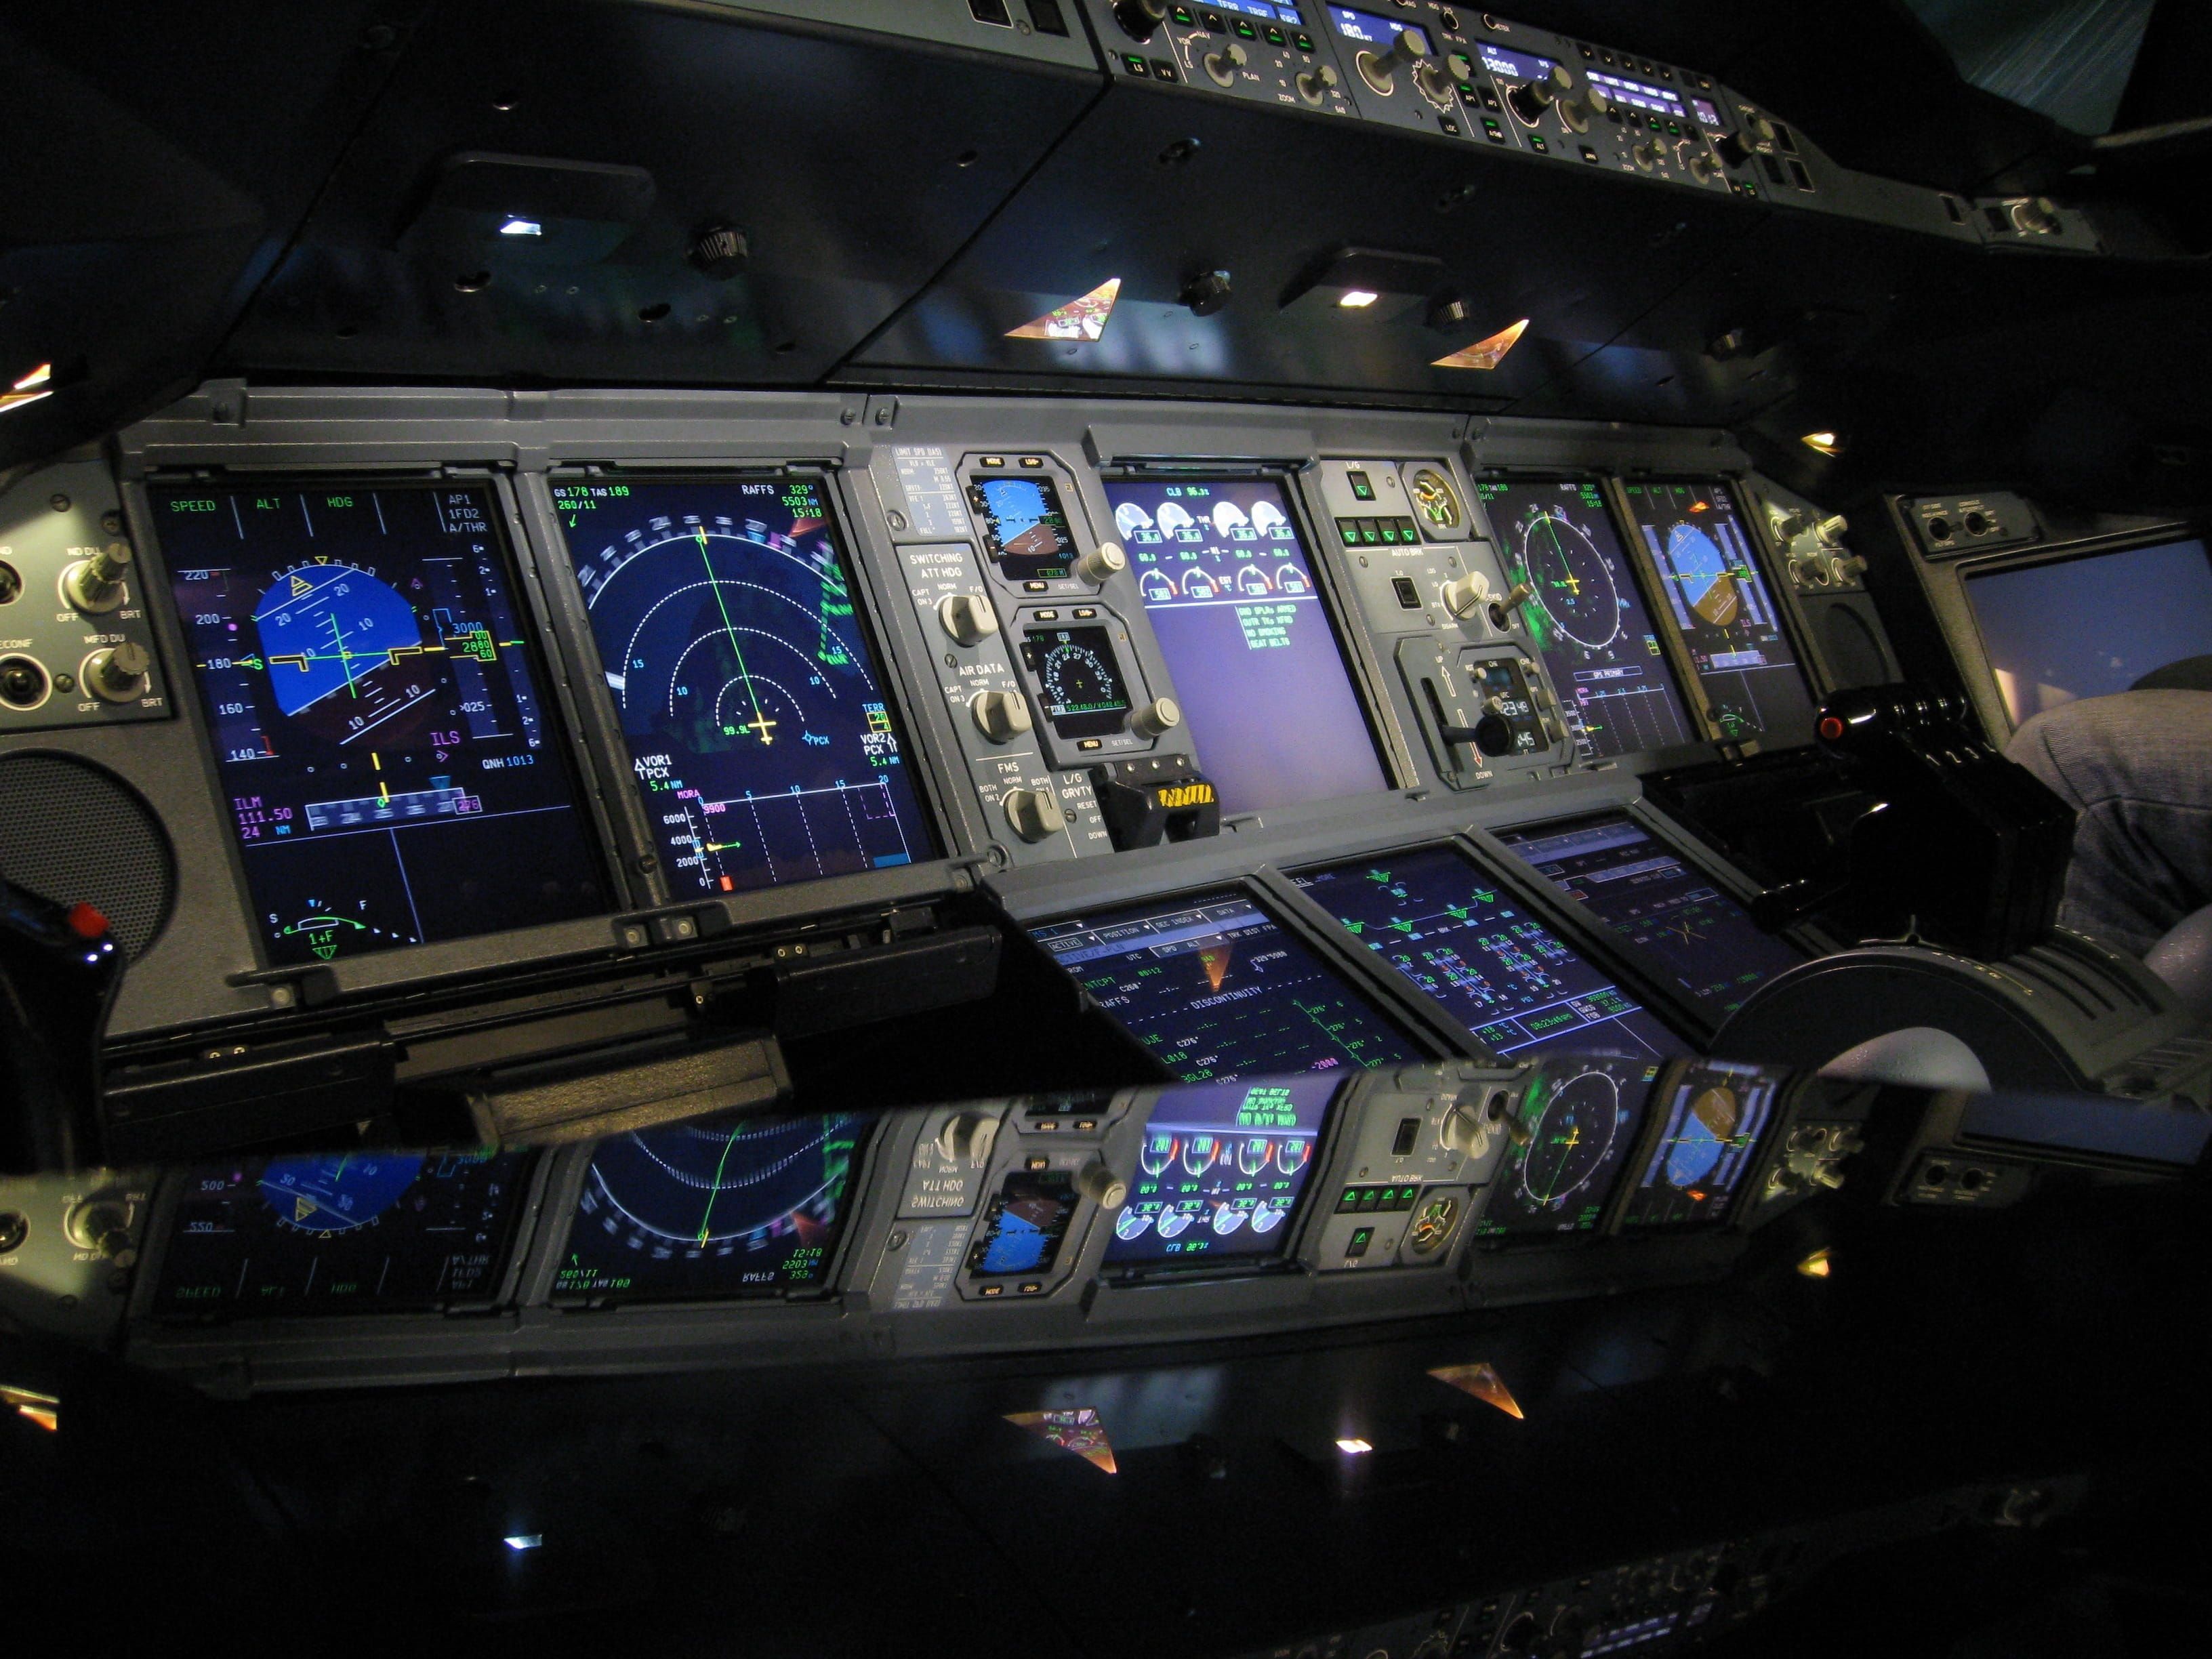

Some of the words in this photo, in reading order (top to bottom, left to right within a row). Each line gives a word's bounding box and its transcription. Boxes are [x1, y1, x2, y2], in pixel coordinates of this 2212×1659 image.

[1134, 64, 1143, 73] LS
[1242, 72, 1261, 81] PLAN
[986, 457, 1002, 466] MODE
[554, 488, 566, 497] GS
[567, 487, 589, 498] 178
[590, 487, 608, 497] TAS
[609, 486, 630, 497] 189
[741, 484, 775, 495] RAFFS
[1166, 487, 1182, 497] CLB
[256, 497, 281, 510] ALT
[327, 497, 353, 508] HDG
[449, 494, 470, 505] AP1
[171, 499, 216, 512] SPEED
[449, 508, 480, 519] 1FD2
[792, 507, 822, 518] 15:18
[449, 523, 487, 533] A/THR
[1391, 548, 1409, 556] AUTO
[909, 552, 963, 565] SWITCHING
[185, 571, 209, 581] 220
[921, 567, 939, 579] ATT
[942, 567, 962, 577] HDG
[334, 583, 350, 597] 20
[937, 582, 957, 592] NORM
[969, 586, 983, 594] F/O
[912, 588, 930, 597] CAPT
[56, 613, 79, 622] OFF
[120, 610, 141, 619] BRT
[196, 613, 220, 625] 200
[1040, 611, 1055, 619] MODE
[275, 613, 292, 627] 20
[359, 617, 374, 632] 10
[452, 622, 483, 634] 3000
[83, 634, 108, 644] MFD
[110, 634, 125, 643] DU
[831, 645, 843, 655] 15
[207, 657, 232, 670] 180
[632, 659, 644, 670] 15
[959, 665, 975, 676] AIR
[976, 663, 1005, 675] DATA
[809, 676, 820, 685] 10
[970, 679, 990, 687] NORM
[1002, 680, 1016, 689] F/O
[405, 684, 421, 698] 10
[676, 686, 688, 697] 10
[944, 685, 962, 694] CAPT
[142, 697, 163, 708] BRT
[950, 695, 960, 703] ON
[78, 702, 100, 712] OFF
[219, 702, 243, 715] 160
[862, 703, 886, 712] TERR
[348, 716, 365, 730] 10
[430, 732, 460, 745] ILS
[814, 735, 830, 745] PCX
[860, 733, 886, 745] VOR2
[1084, 740, 1099, 748] MENU
[230, 748, 255, 760] 140
[864, 745, 883, 756] PCX
[483, 757, 504, 770] QNH
[506, 754, 534, 766] 1013
[644, 754, 672, 767] VOR1
[870, 756, 888, 766] 5.4
[647, 766, 668, 779] PCX
[998, 762, 1019, 773] FMS
[878, 775, 889, 783] 20
[1003, 776, 1022, 784] NORM
[1063, 773, 1082, 783] L/G
[1475, 771, 1493, 779] DOWN
[650, 780, 669, 792] 5.4
[670, 780, 682, 790] NM
[835, 779, 846, 789] 15
[1030, 777, 1049, 787] BOTH
[790, 785, 801, 794] 10
[979, 783, 998, 793] BOTH
[1062, 785, 1092, 798] GRVTY
[677, 790, 700, 800] MORA
[745, 790, 752, 799] 5
[985, 794, 995, 802] ON
[234, 796, 262, 810] ILM
[703, 803, 726, 813] 9900
[1077, 800, 1097, 810] RESET
[239, 807, 293, 825] 111.50
[663, 813, 687, 825] 6000
[1089, 815, 1102, 823] OFF
[241, 826, 260, 840] 24
[1088, 831, 1108, 840] DOWN
[670, 834, 693, 846] 4000
[676, 856, 699, 868] 2000
[699, 878, 705, 887] 0
[359, 899, 367, 911] F
[268, 914, 278, 923] S
[1103, 927, 1139, 939] POSITION
[1227, 932, 1242, 940] TRK
[1263, 924, 1277, 933] FPA
[309, 930, 333, 945] 1+F
[1052, 939, 1080, 949] ACTIVE
[1187, 940, 1200, 948] ALT
[1190, 986, 1264, 1009] DISCONTINUITY
